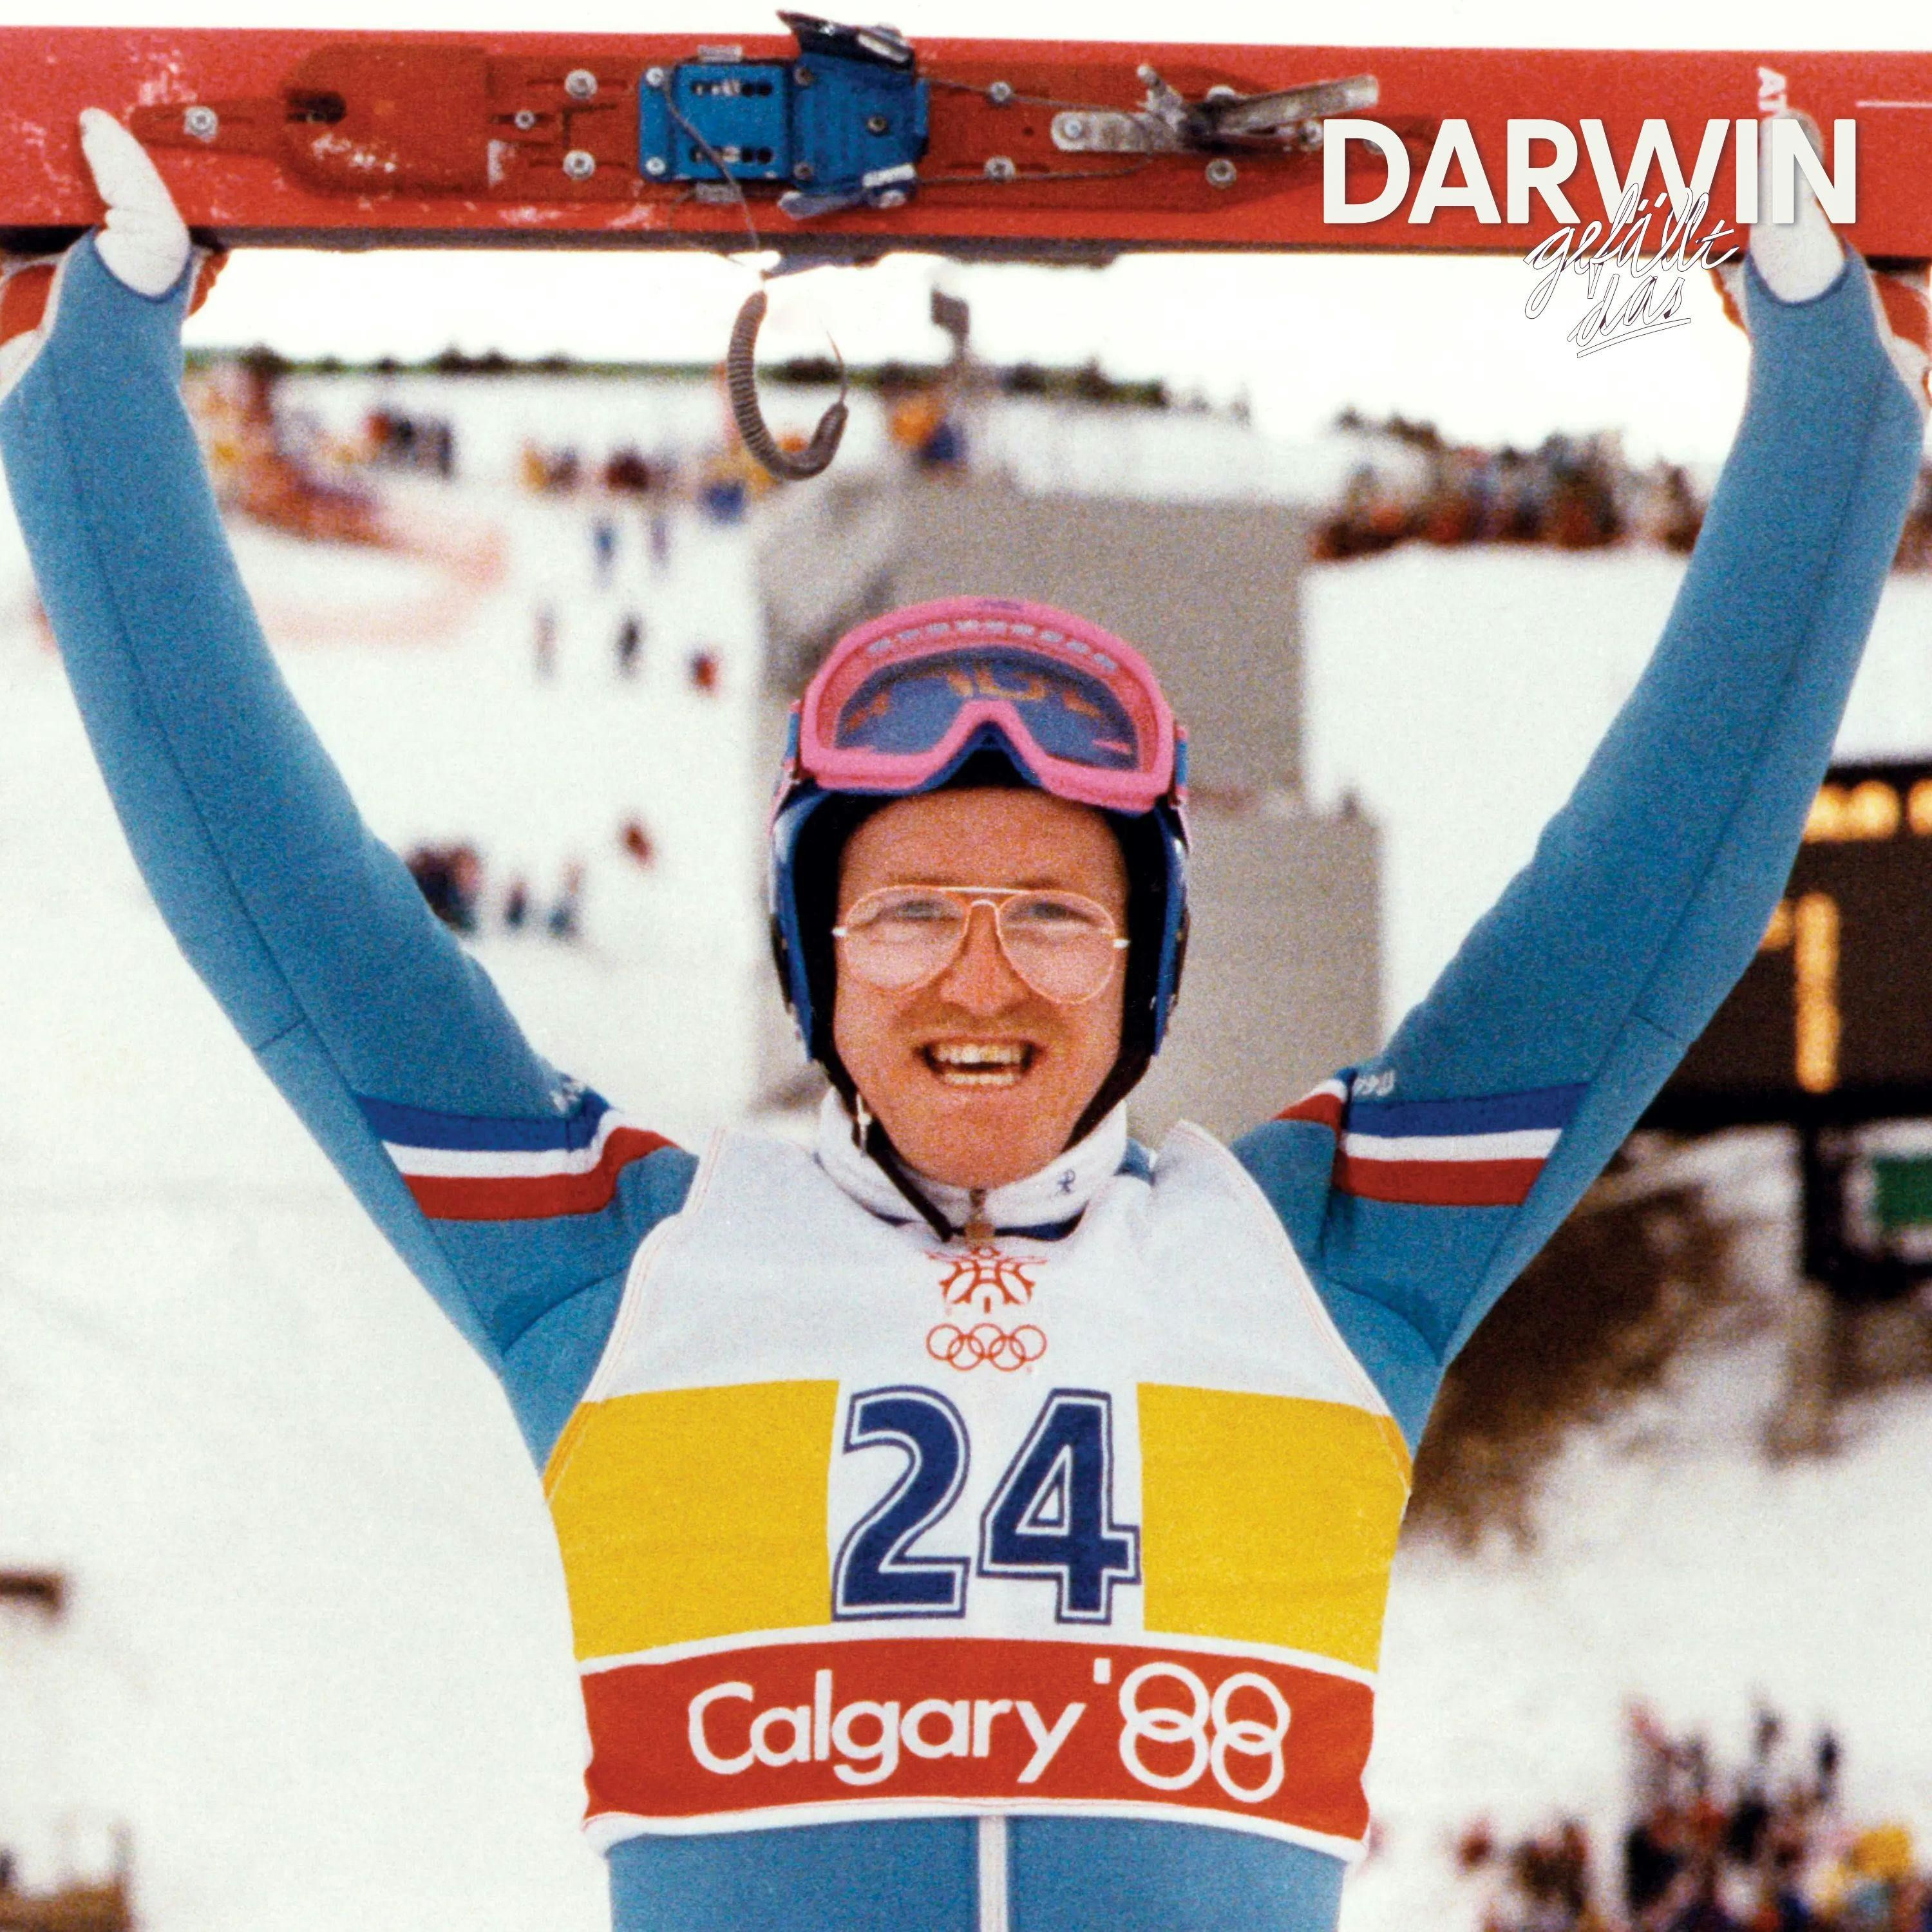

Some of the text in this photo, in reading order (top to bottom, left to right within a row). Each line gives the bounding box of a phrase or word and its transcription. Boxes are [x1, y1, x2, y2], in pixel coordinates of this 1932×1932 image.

[831, 1385, 1141, 1625] 24
[688, 1658, 1291, 1803] Calgary '88
